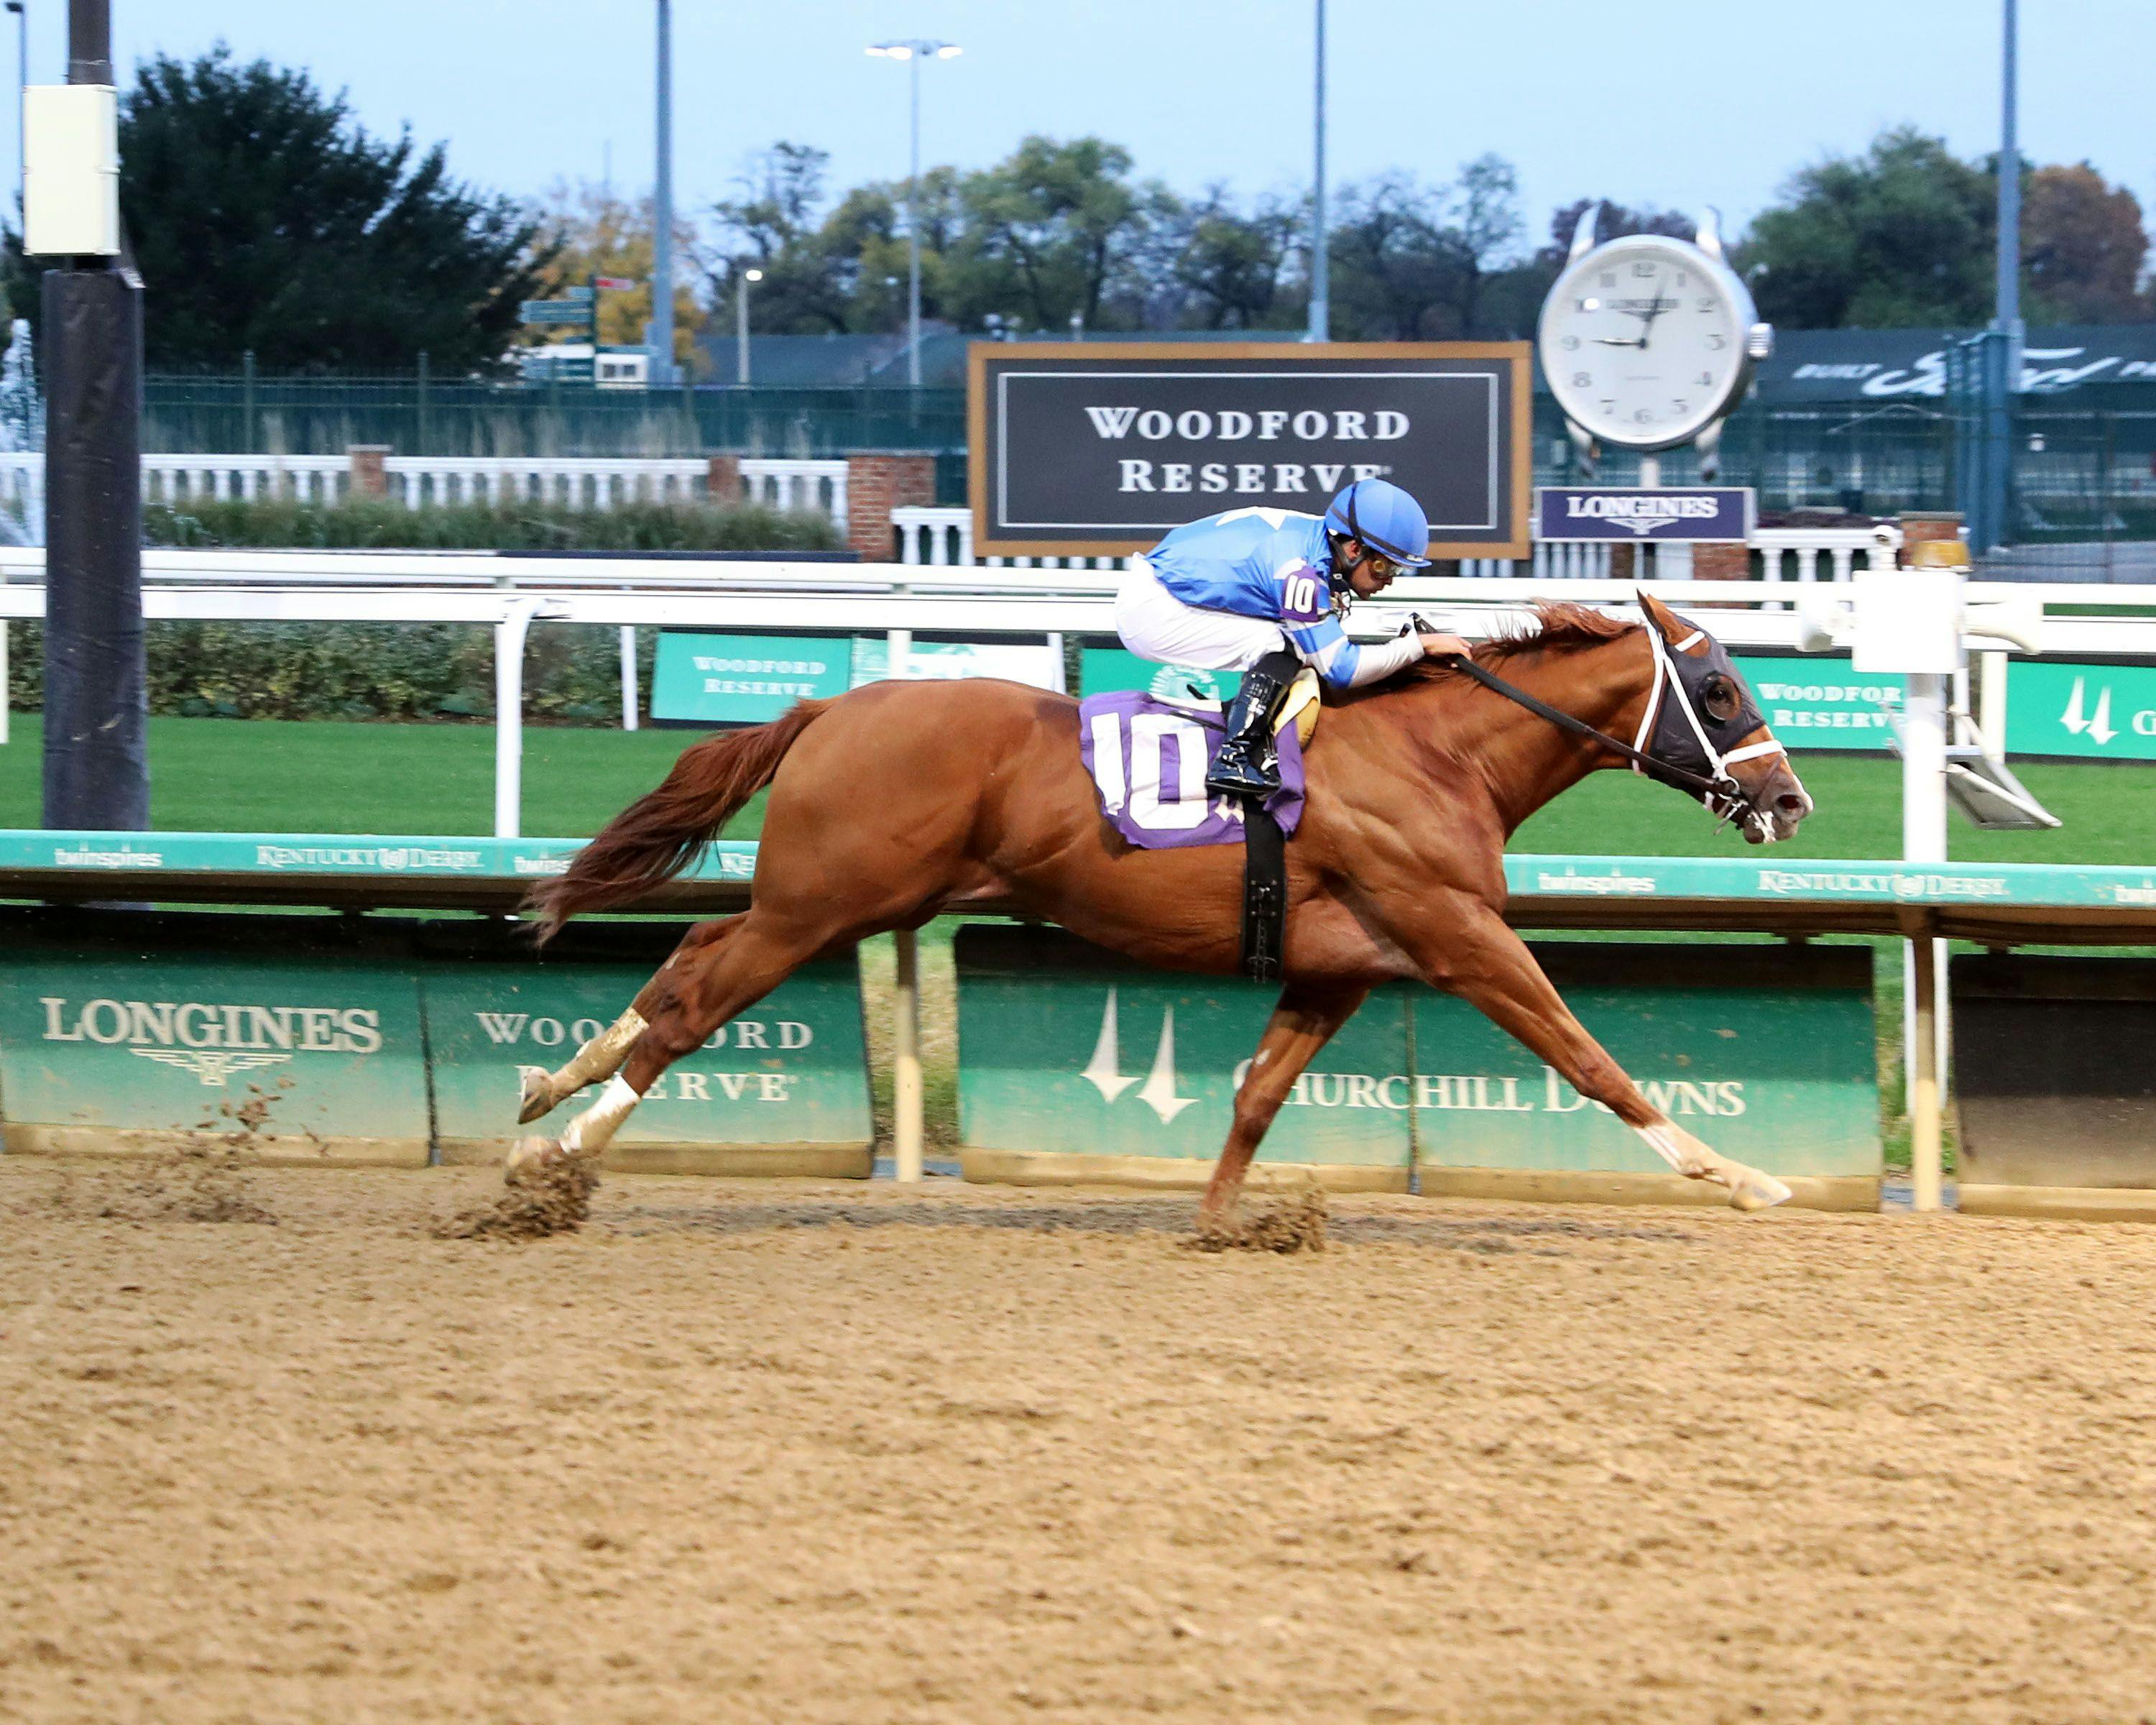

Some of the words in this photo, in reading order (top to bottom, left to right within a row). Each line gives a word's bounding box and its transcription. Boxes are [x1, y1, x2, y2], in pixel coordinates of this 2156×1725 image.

[1572, 371, 1593, 388] 8
[1084, 407, 1410, 441] WOODFORD
[1567, 497, 1719, 518] LONGINES
[1284, 574, 1316, 614] 10
[692, 656, 826, 675] WOODFORD
[703, 678, 816, 696] RESERVE
[1757, 683, 1904, 702] WOODFOR
[1090, 712, 1209, 829] 10
[257, 846, 380, 868] KENTUCKY
[408, 848, 484, 869] DERBY
[1756, 870, 1890, 893] KENTUCKY
[1925, 875, 2008, 898] DERBY
[40, 997, 382, 1053] LONGINES
[474, 1013, 814, 1049] WOOORD
[1540, 1065, 1746, 1116] DWNS
